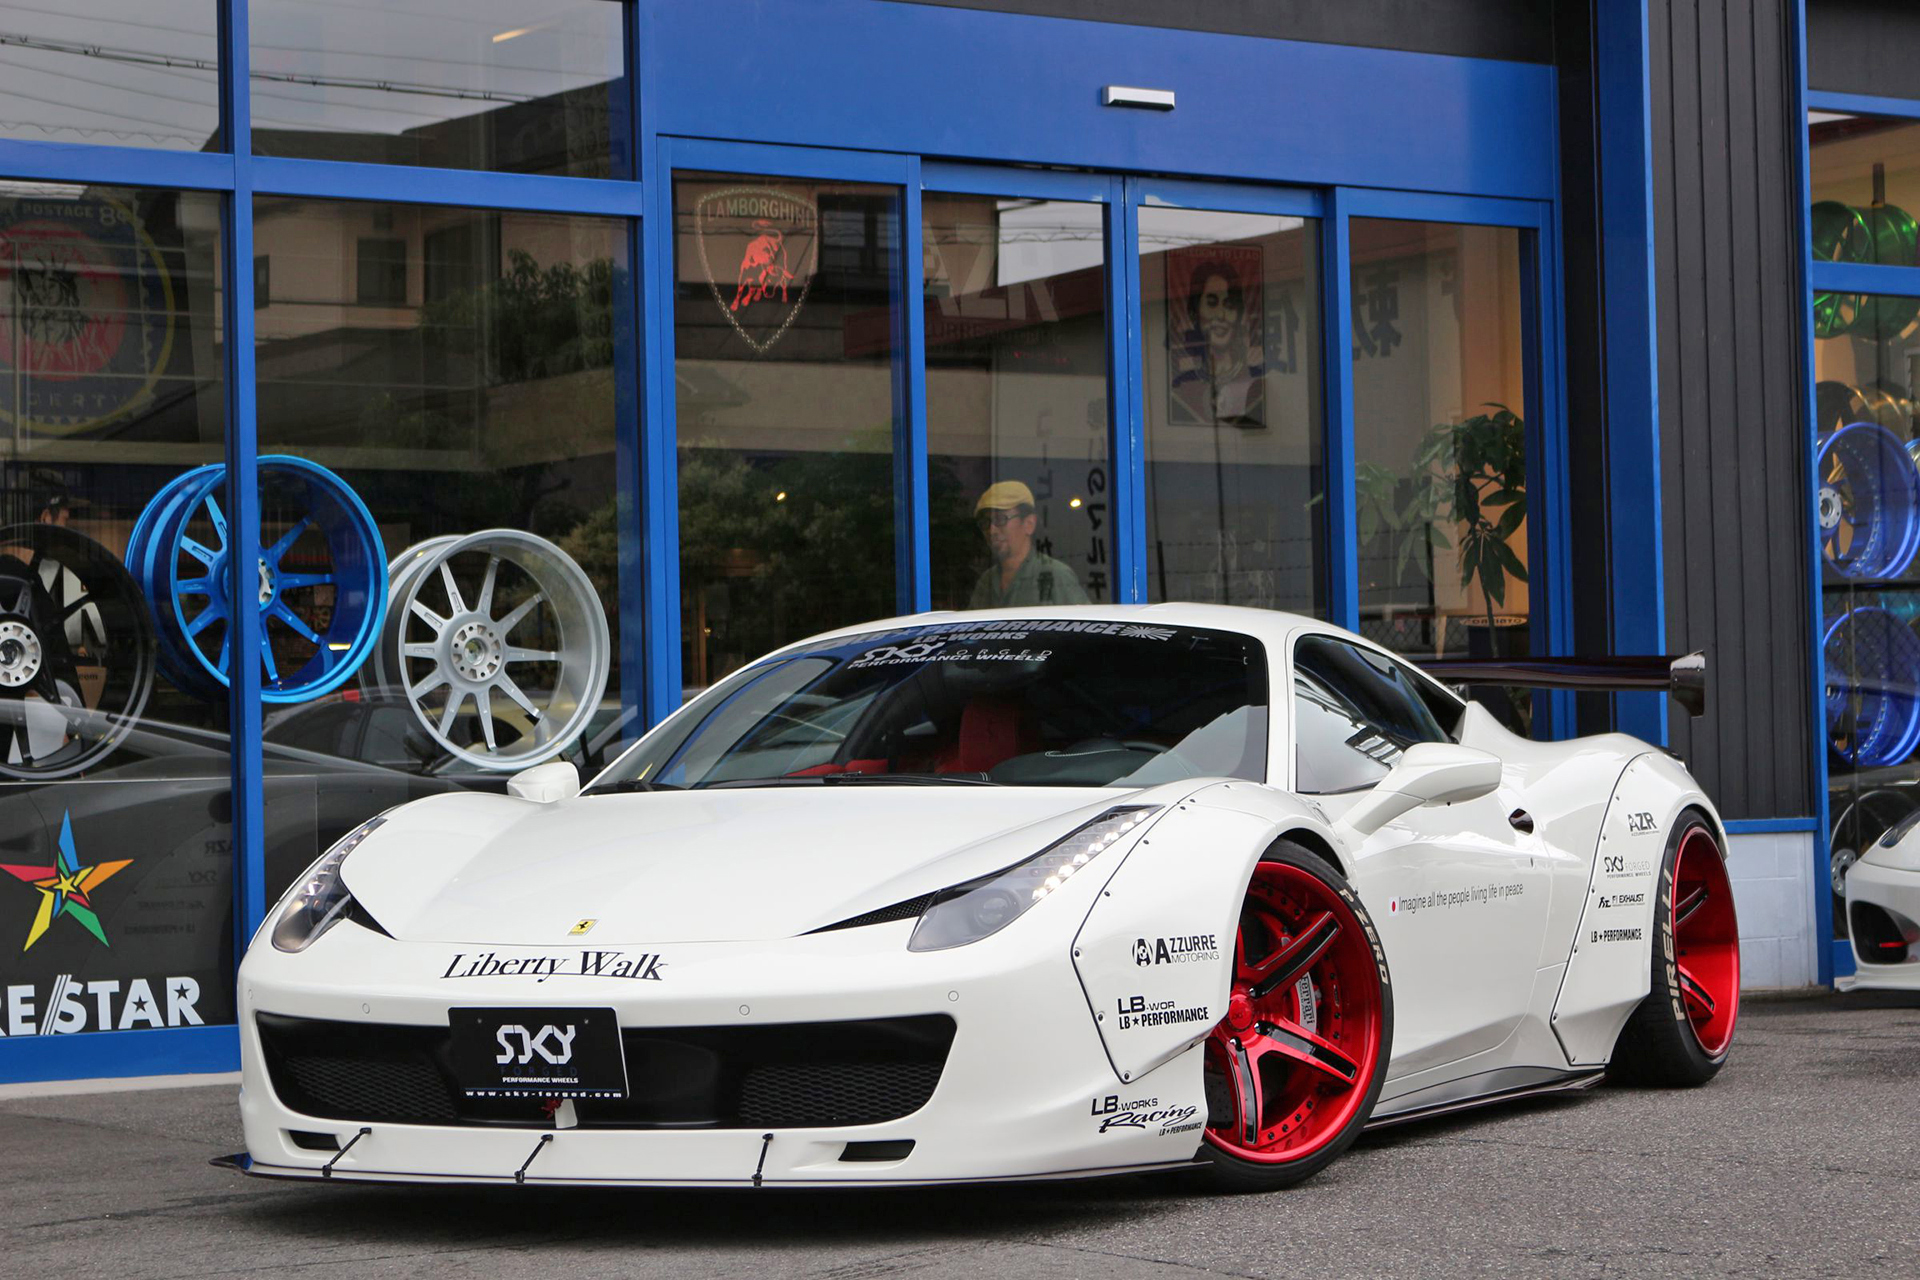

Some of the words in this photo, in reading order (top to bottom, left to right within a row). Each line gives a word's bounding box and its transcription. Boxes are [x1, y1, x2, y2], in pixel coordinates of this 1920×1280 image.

[707, 198, 811, 227] LAMBORGHINI
[912, 631, 1029, 645] LB-WORKS
[916, 620, 1122, 637] PERFORMANCE
[847, 654, 973, 670] PERFORMANCE
[976, 653, 1049, 662] WHEELS
[1628, 812, 1658, 832] AZR
[1625, 861, 1651, 872] FORGED
[1399, 893, 1426, 914] Imagine
[1427, 891, 1436, 908] all
[1437, 890, 1447, 906] the
[1448, 887, 1470, 909] people
[1471, 885, 1488, 904] living
[1489, 883, 1498, 899] life
[1499, 883, 1505, 898] in
[1505, 883, 1524, 901] peace
[1619, 893, 1645, 904] EXHAUST
[1591, 931, 1598, 943] LB
[1604, 928, 1642, 942] PERFORMANCE
[1662, 868, 1686, 1021] PIRELLI
[1155, 934, 1218, 965] AZZURRE
[1354, 908, 1389, 985] ZERO
[439, 952, 571, 983] Liberty
[580, 951, 669, 981] Walk
[1171, 951, 1220, 963] MOTORING
[1301, 976, 1315, 1024] Ferrari
[1119, 1016, 1131, 1030] LB
[1141, 1007, 1209, 1027] PERFORMANCE
[496, 1024, 576, 1065] SKY
[500, 1066, 578, 1077] FORGED
[465, 1090, 622, 1098] www.sky-forged.com
[1098, 1104, 1199, 1133] Racing
[1170, 1121, 1203, 1135] PERFORMANCE
